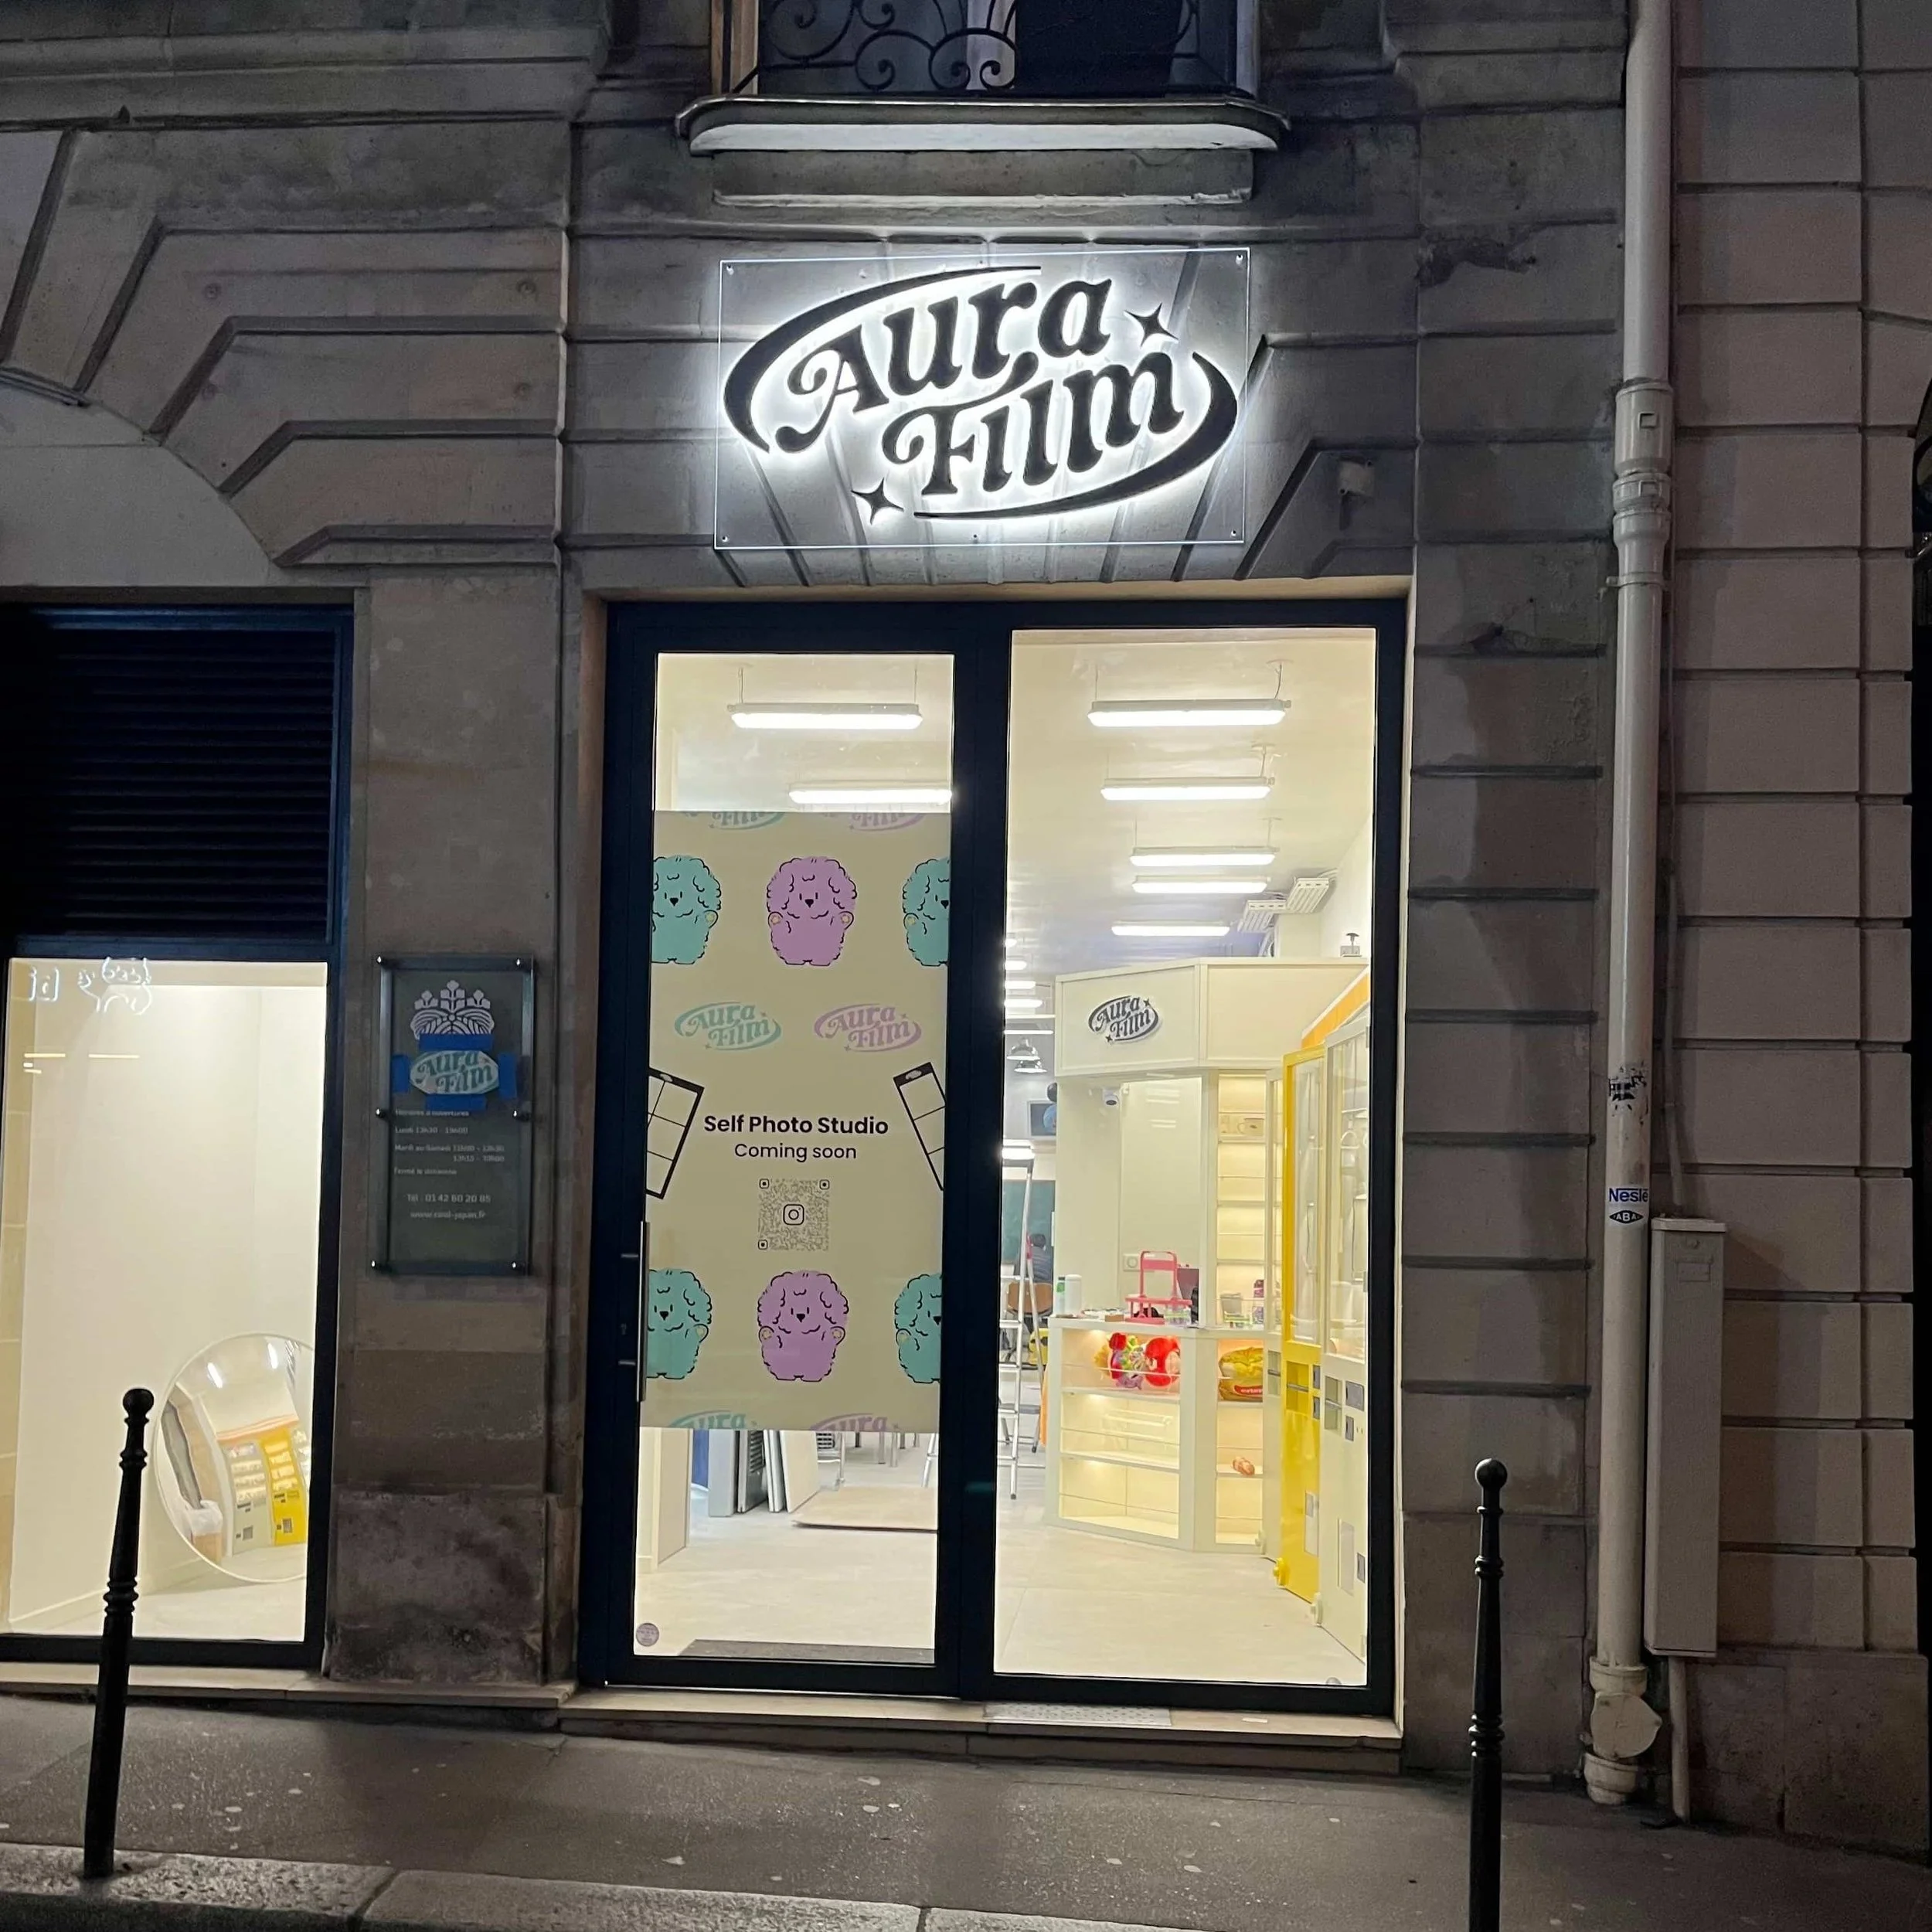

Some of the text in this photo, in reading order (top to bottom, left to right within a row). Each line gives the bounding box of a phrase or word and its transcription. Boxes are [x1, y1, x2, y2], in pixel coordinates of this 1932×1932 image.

[774, 278, 1112, 453] Aura
[882, 350, 1184, 495] Film
[685, 1005, 756, 1037] Aura
[825, 1007, 896, 1039] Aura
[1095, 997, 1141, 1032] Aura
[1110, 1009, 1151, 1037] Film
[708, 1019, 770, 1046] Film
[848, 1021, 910, 1047] Film
[414, 1052, 479, 1083] Aura
[436, 1064, 493, 1092] Film
[704, 1114, 889, 1134] Self Photo Studio
[734, 1142, 857, 1163] Coming soon
